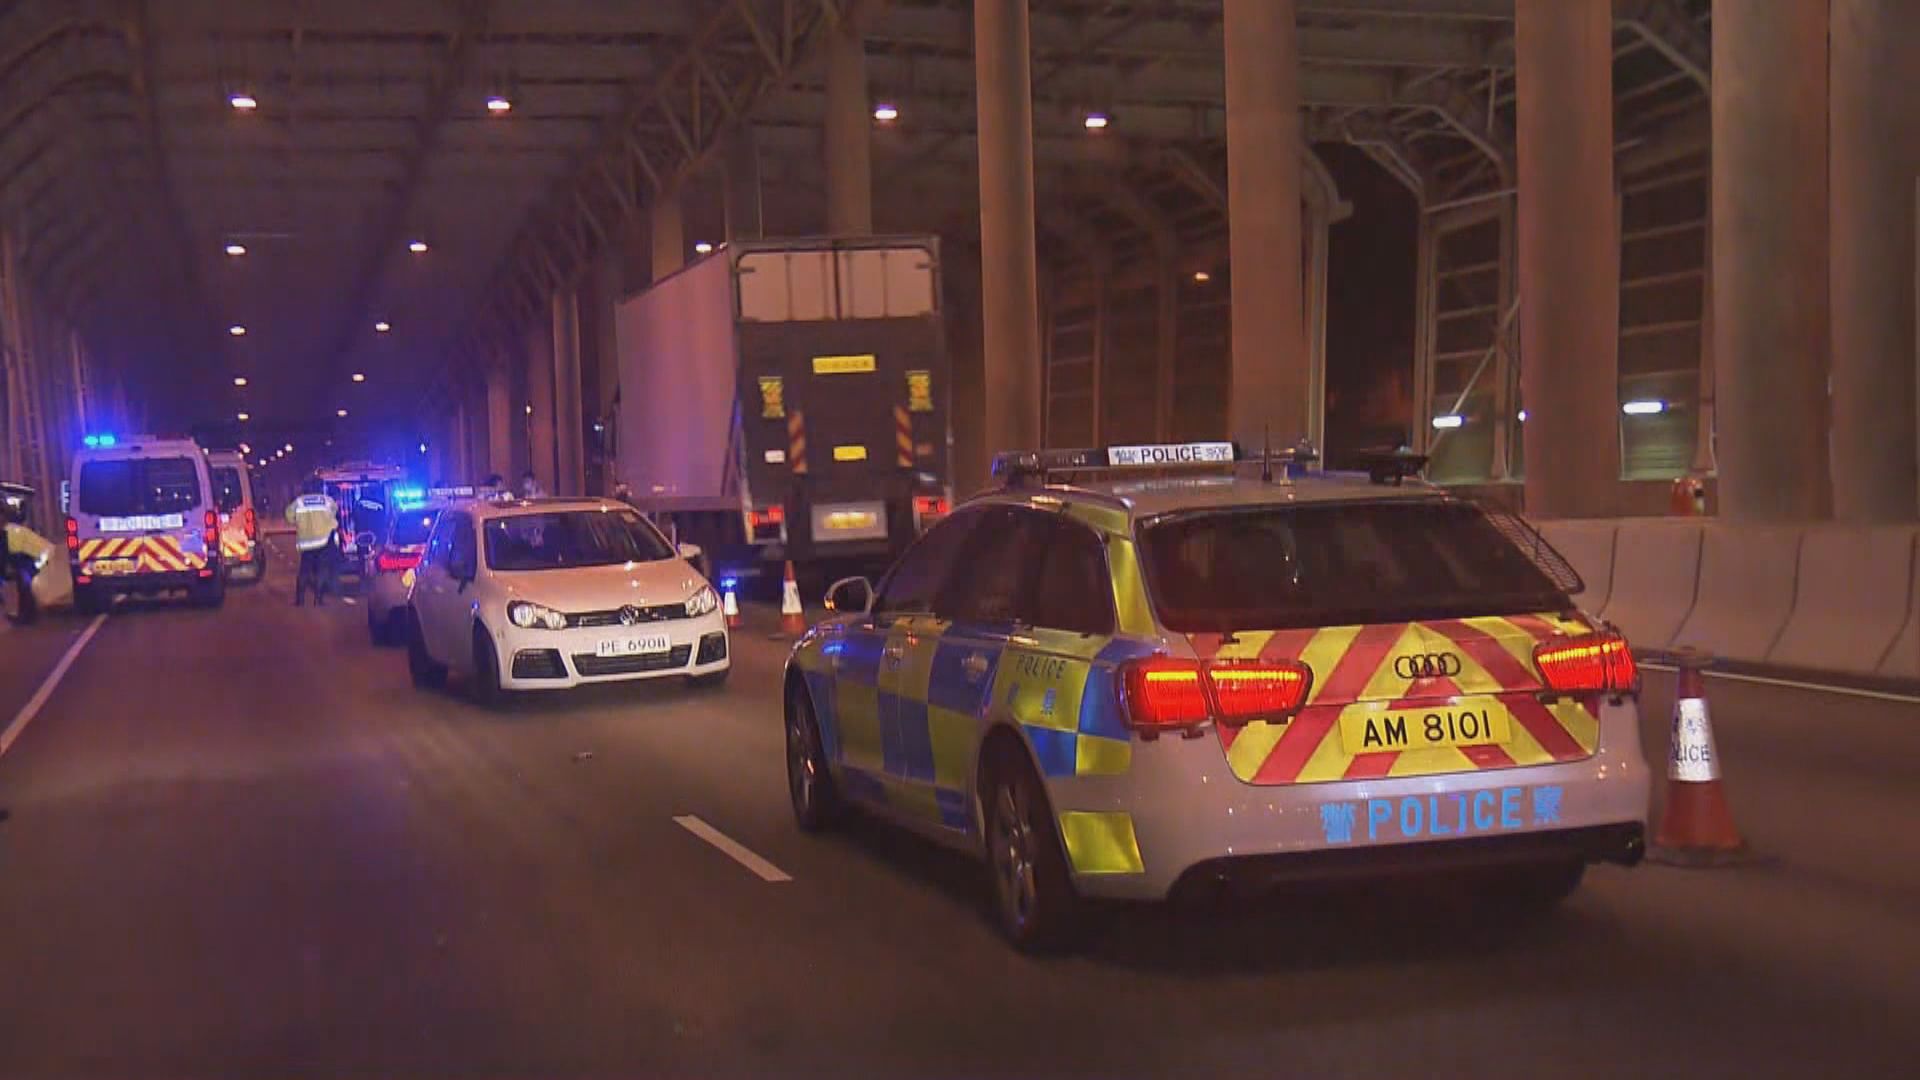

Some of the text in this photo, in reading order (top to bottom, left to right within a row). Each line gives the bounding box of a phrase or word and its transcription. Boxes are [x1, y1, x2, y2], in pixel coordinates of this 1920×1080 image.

[1140, 446, 1201, 464] POLICE
[601, 640, 619, 654] PE
[1015, 654, 1067, 681] POLICE
[1363, 709, 1492, 747] AM 8101
[1367, 786, 1523, 841] POLICE
